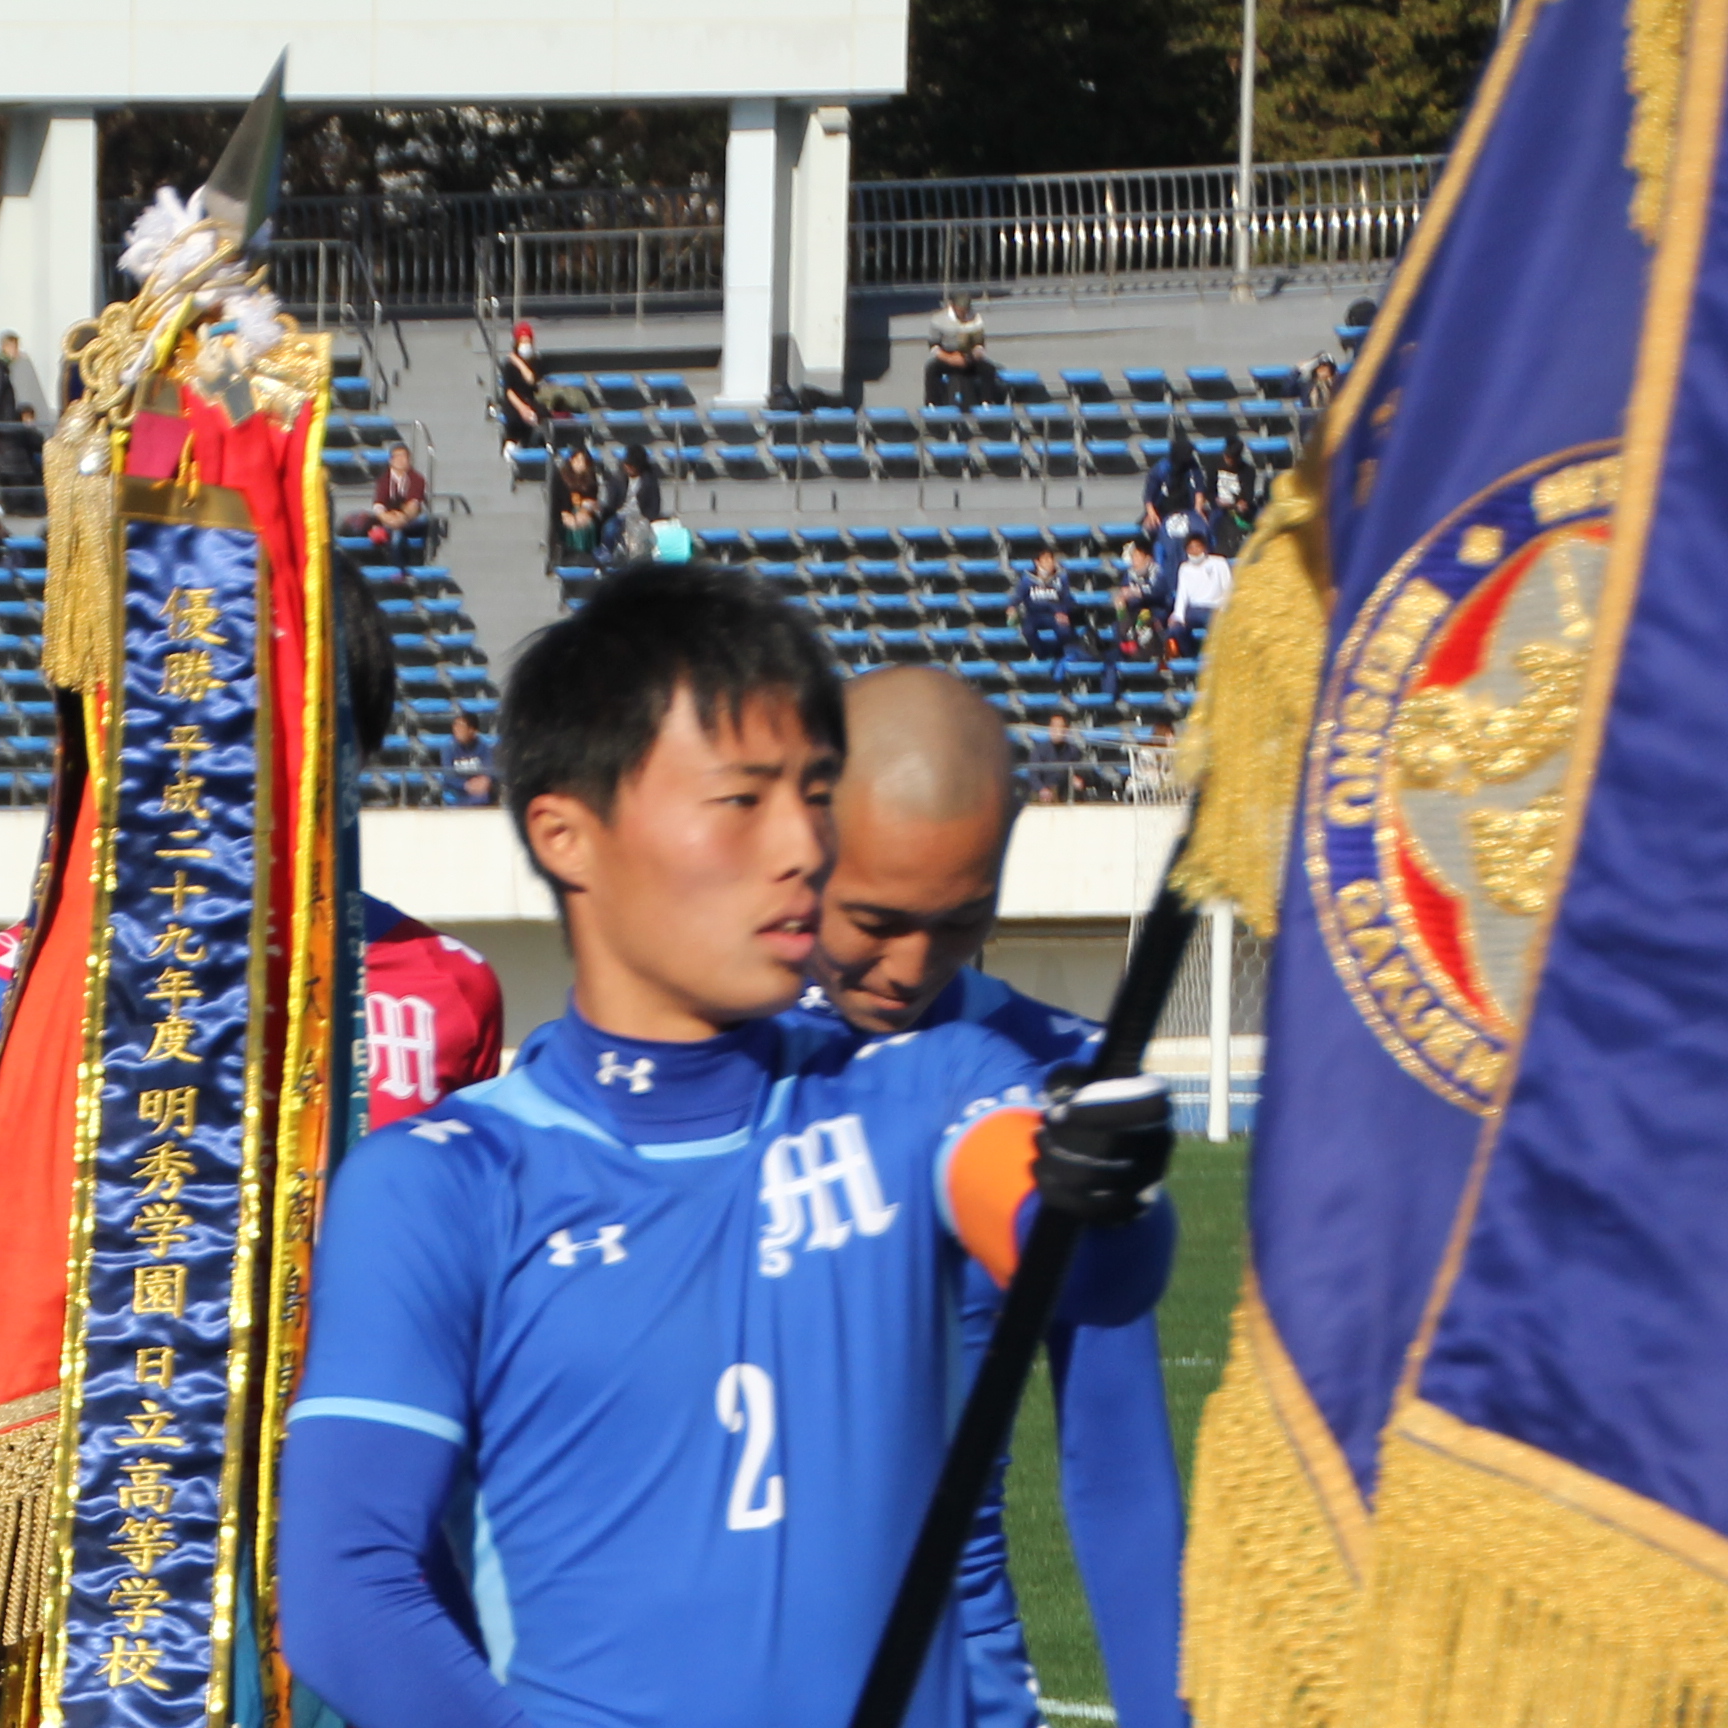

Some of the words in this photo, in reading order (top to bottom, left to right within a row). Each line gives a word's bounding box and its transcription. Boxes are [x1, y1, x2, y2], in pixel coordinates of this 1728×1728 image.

[157, 584, 228, 704] 優勝
[141, 724, 214, 1063] 平成二十九年度
[1335, 876, 1510, 1094] GAKUEN
[715, 1363, 785, 1532] 2
